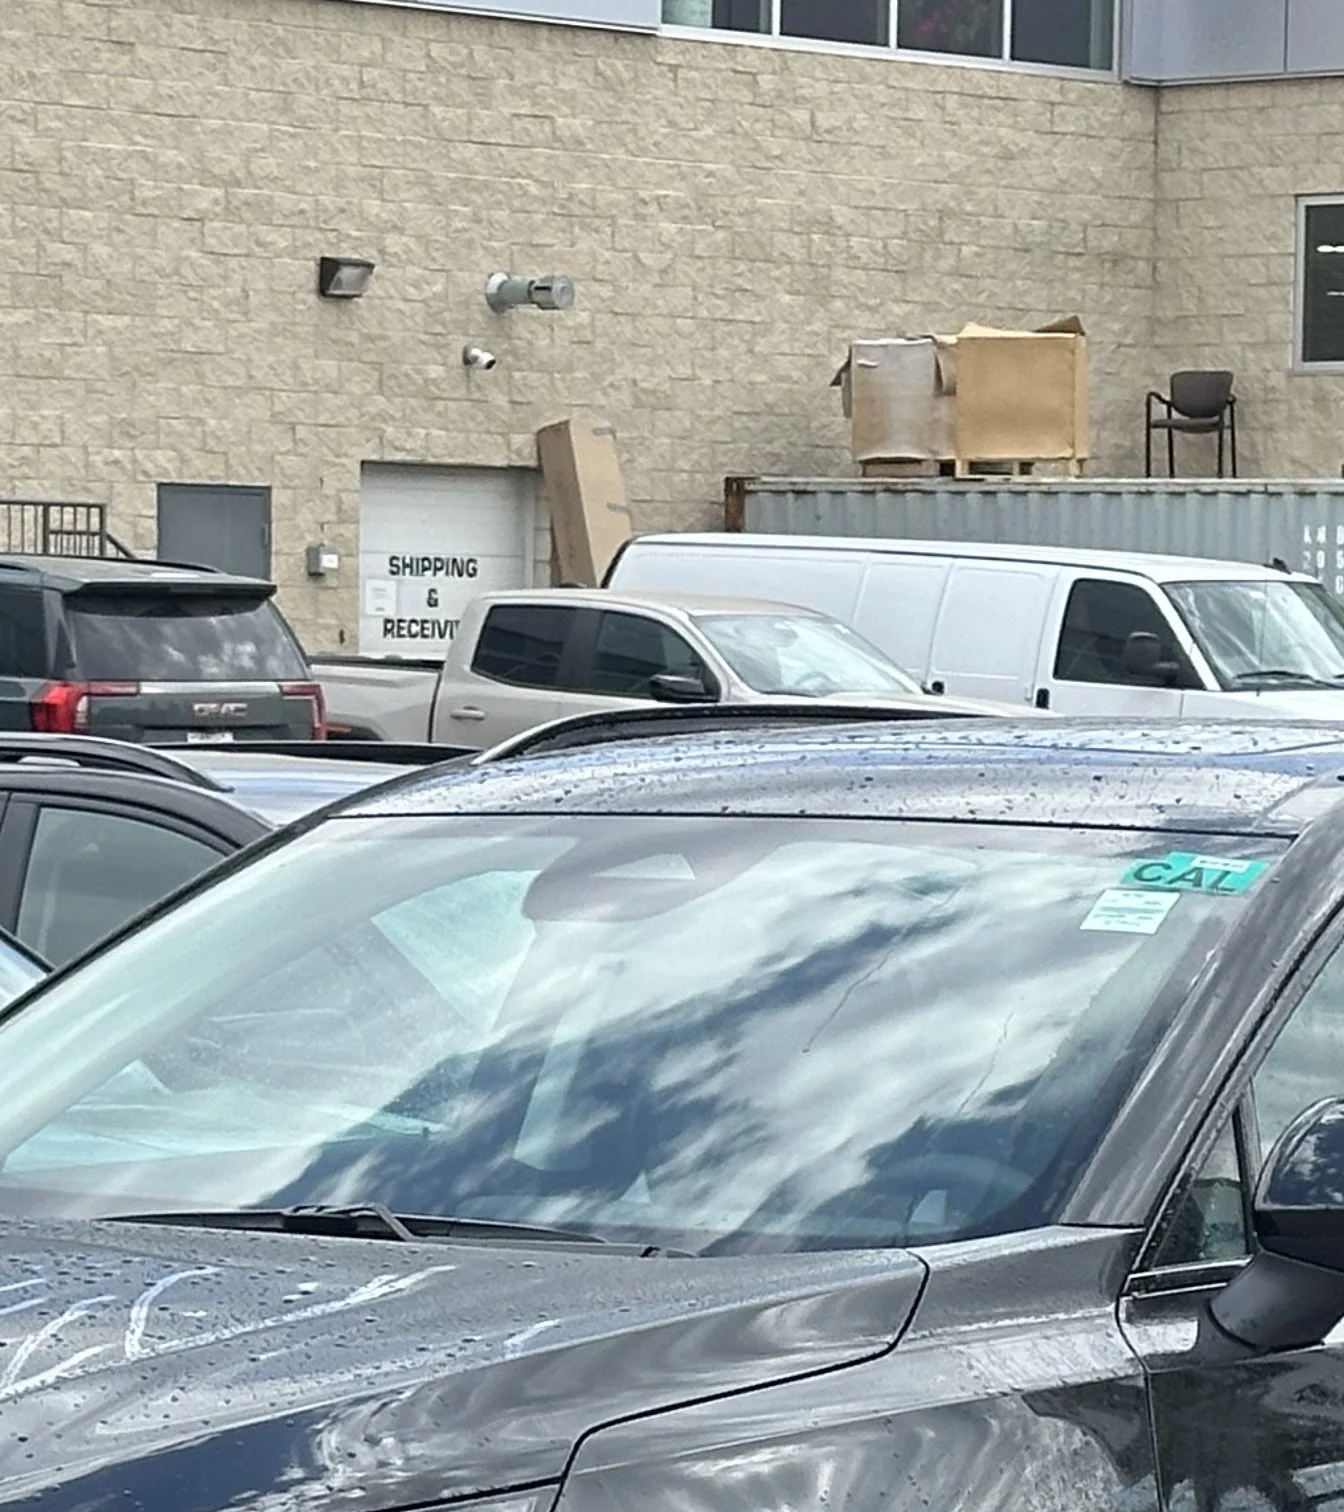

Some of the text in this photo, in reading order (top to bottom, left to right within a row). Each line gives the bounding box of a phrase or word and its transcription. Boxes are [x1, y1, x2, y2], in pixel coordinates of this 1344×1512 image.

[388, 555, 478, 578] SHIPPING
[427, 588, 439, 608] &
[383, 618, 460, 640] RECEIVI
[1133, 861, 1236, 893] CAL
